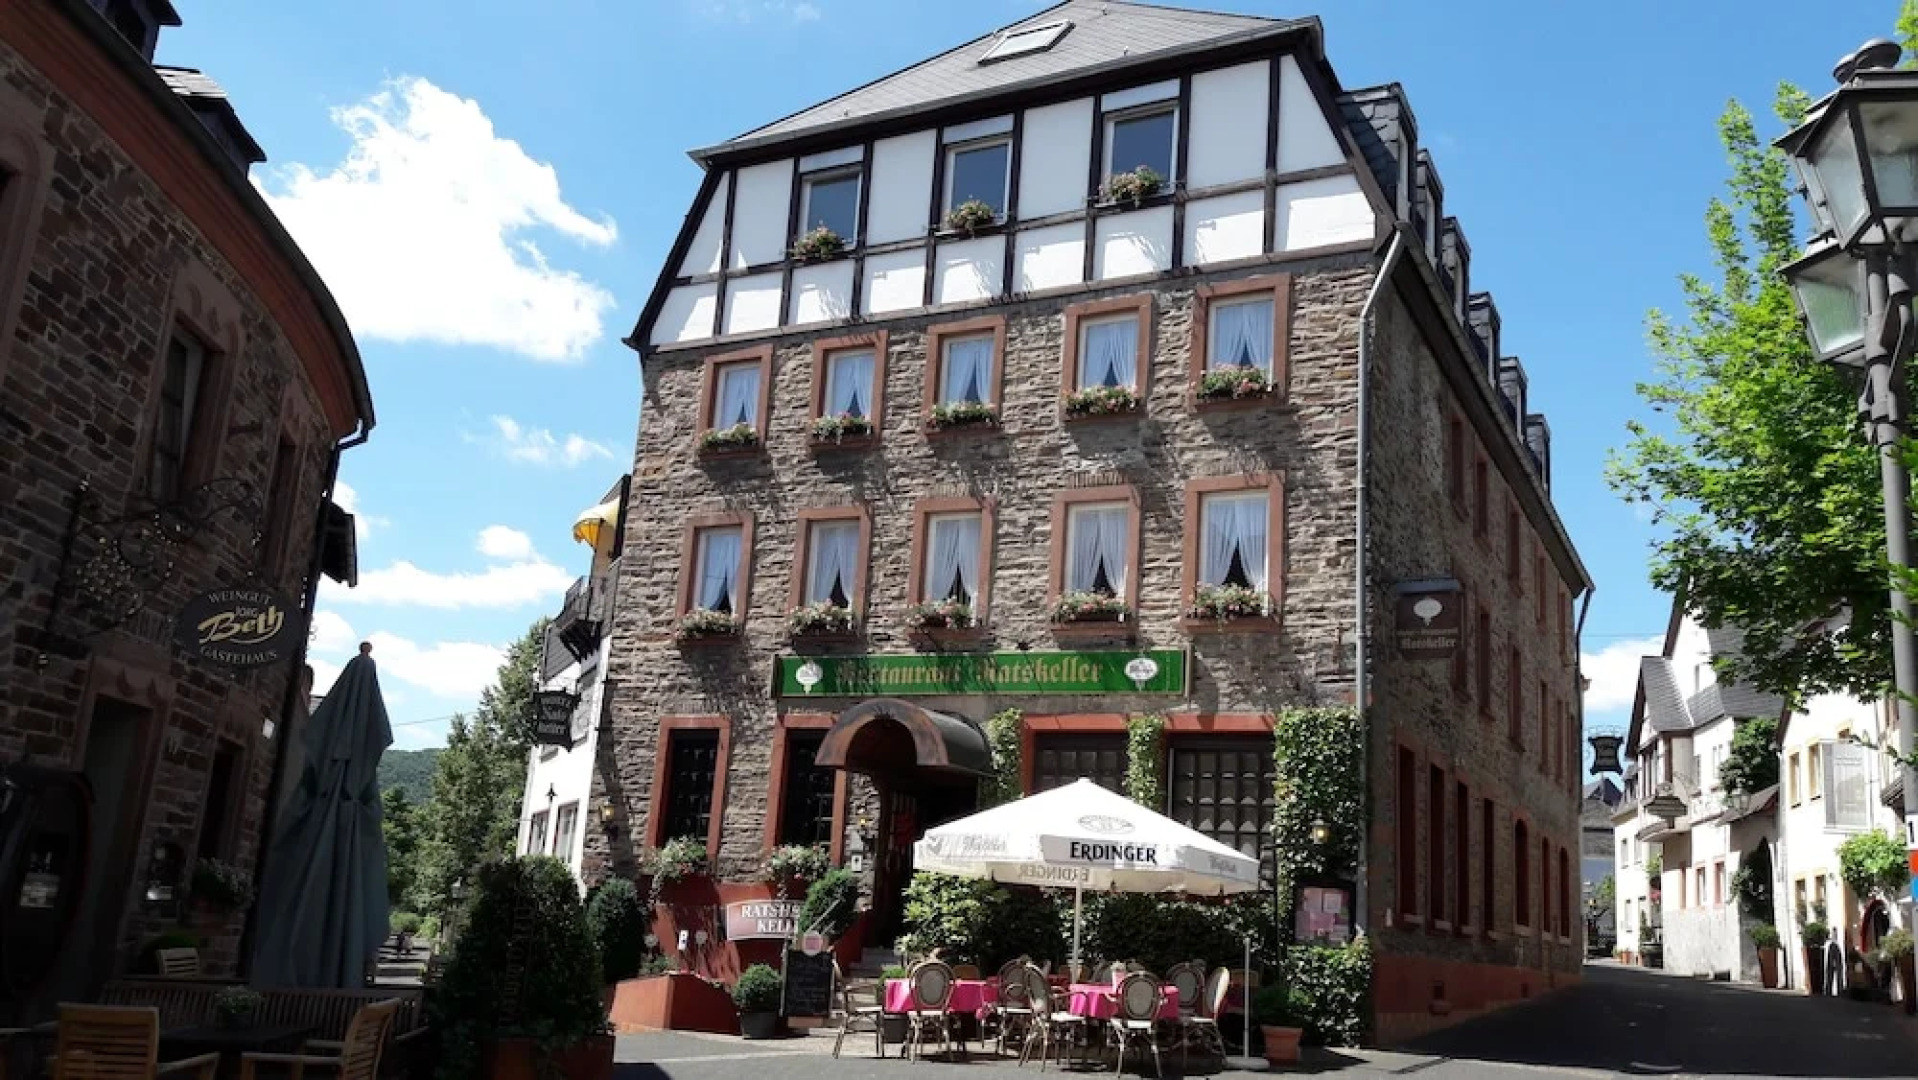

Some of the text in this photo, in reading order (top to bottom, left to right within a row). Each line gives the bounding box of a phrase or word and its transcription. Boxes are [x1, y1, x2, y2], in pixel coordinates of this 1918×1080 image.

[208, 590, 272, 605] WEINGUT
[976, 656, 1103, 684] Ratskeller
[1070, 841, 1157, 866] ERDINGER
